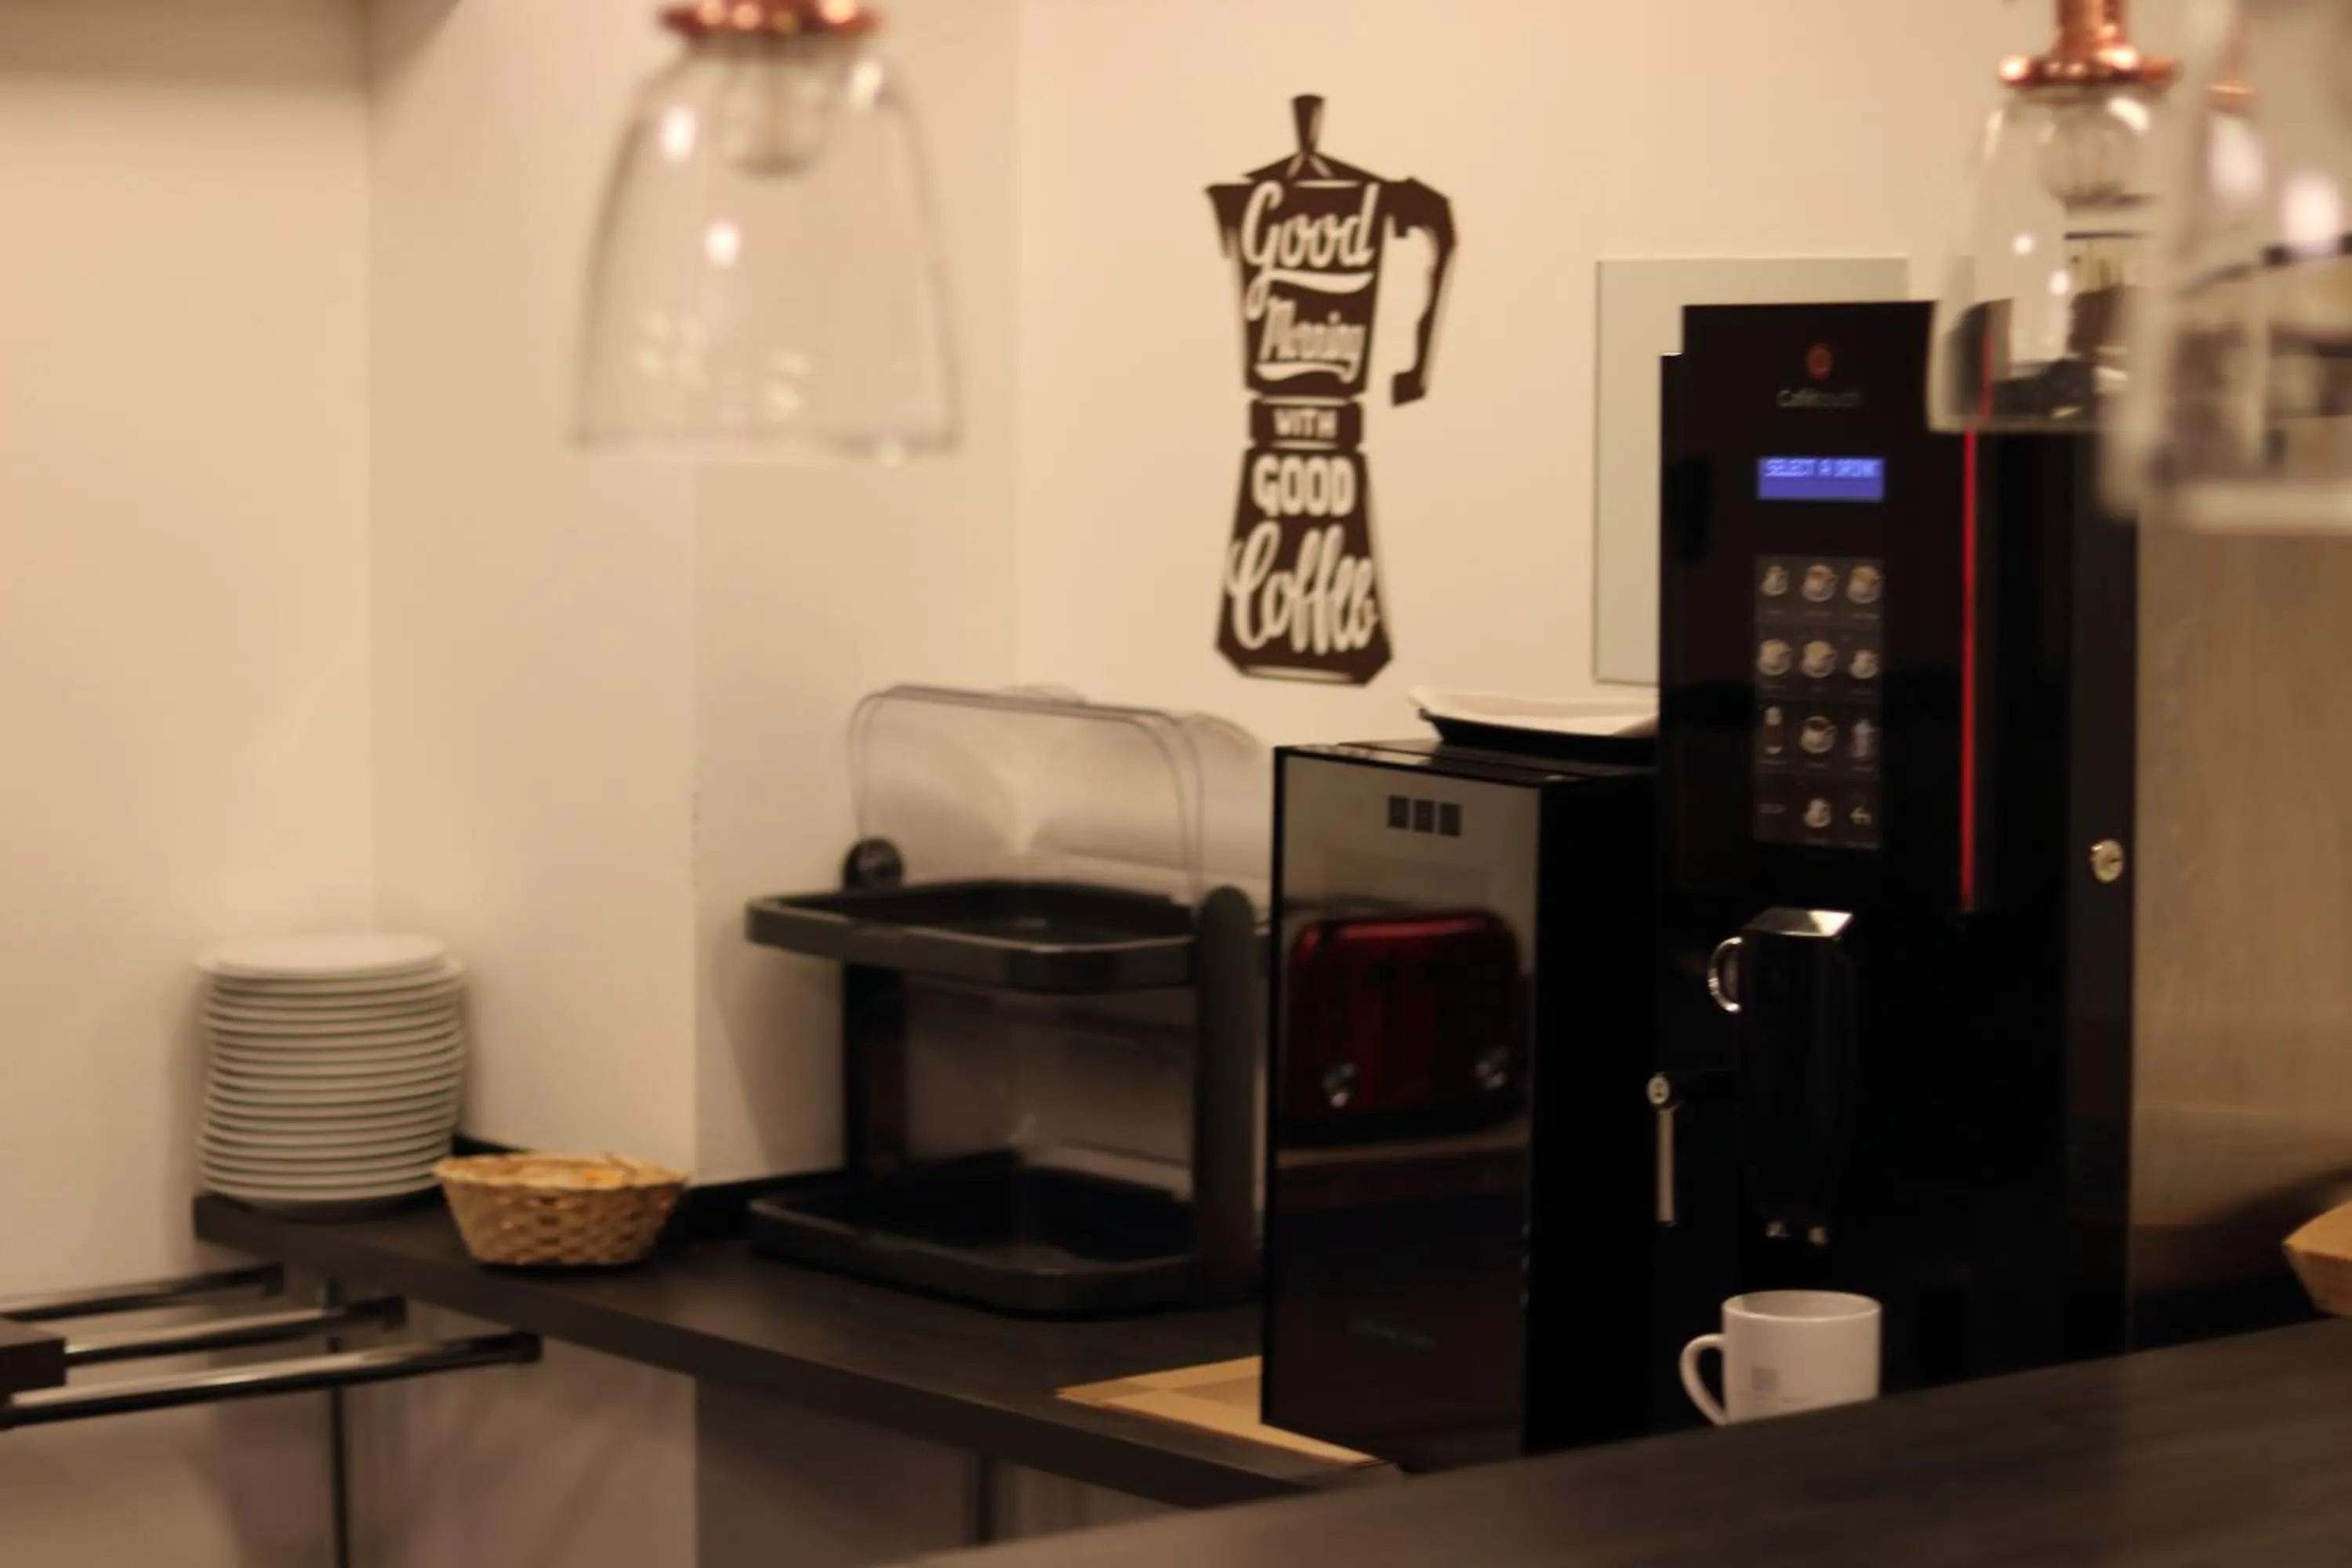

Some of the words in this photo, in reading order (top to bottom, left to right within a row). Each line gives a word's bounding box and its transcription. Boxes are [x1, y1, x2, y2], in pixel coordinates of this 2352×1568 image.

[1240, 180, 1379, 321] Good
[1254, 295, 1367, 383] Morning
[1273, 407, 1338, 438] WITH
[1252, 453, 1357, 517] GOOD
[1764, 459, 1816, 477] SELECT
[1225, 521, 1380, 655] Coffee
